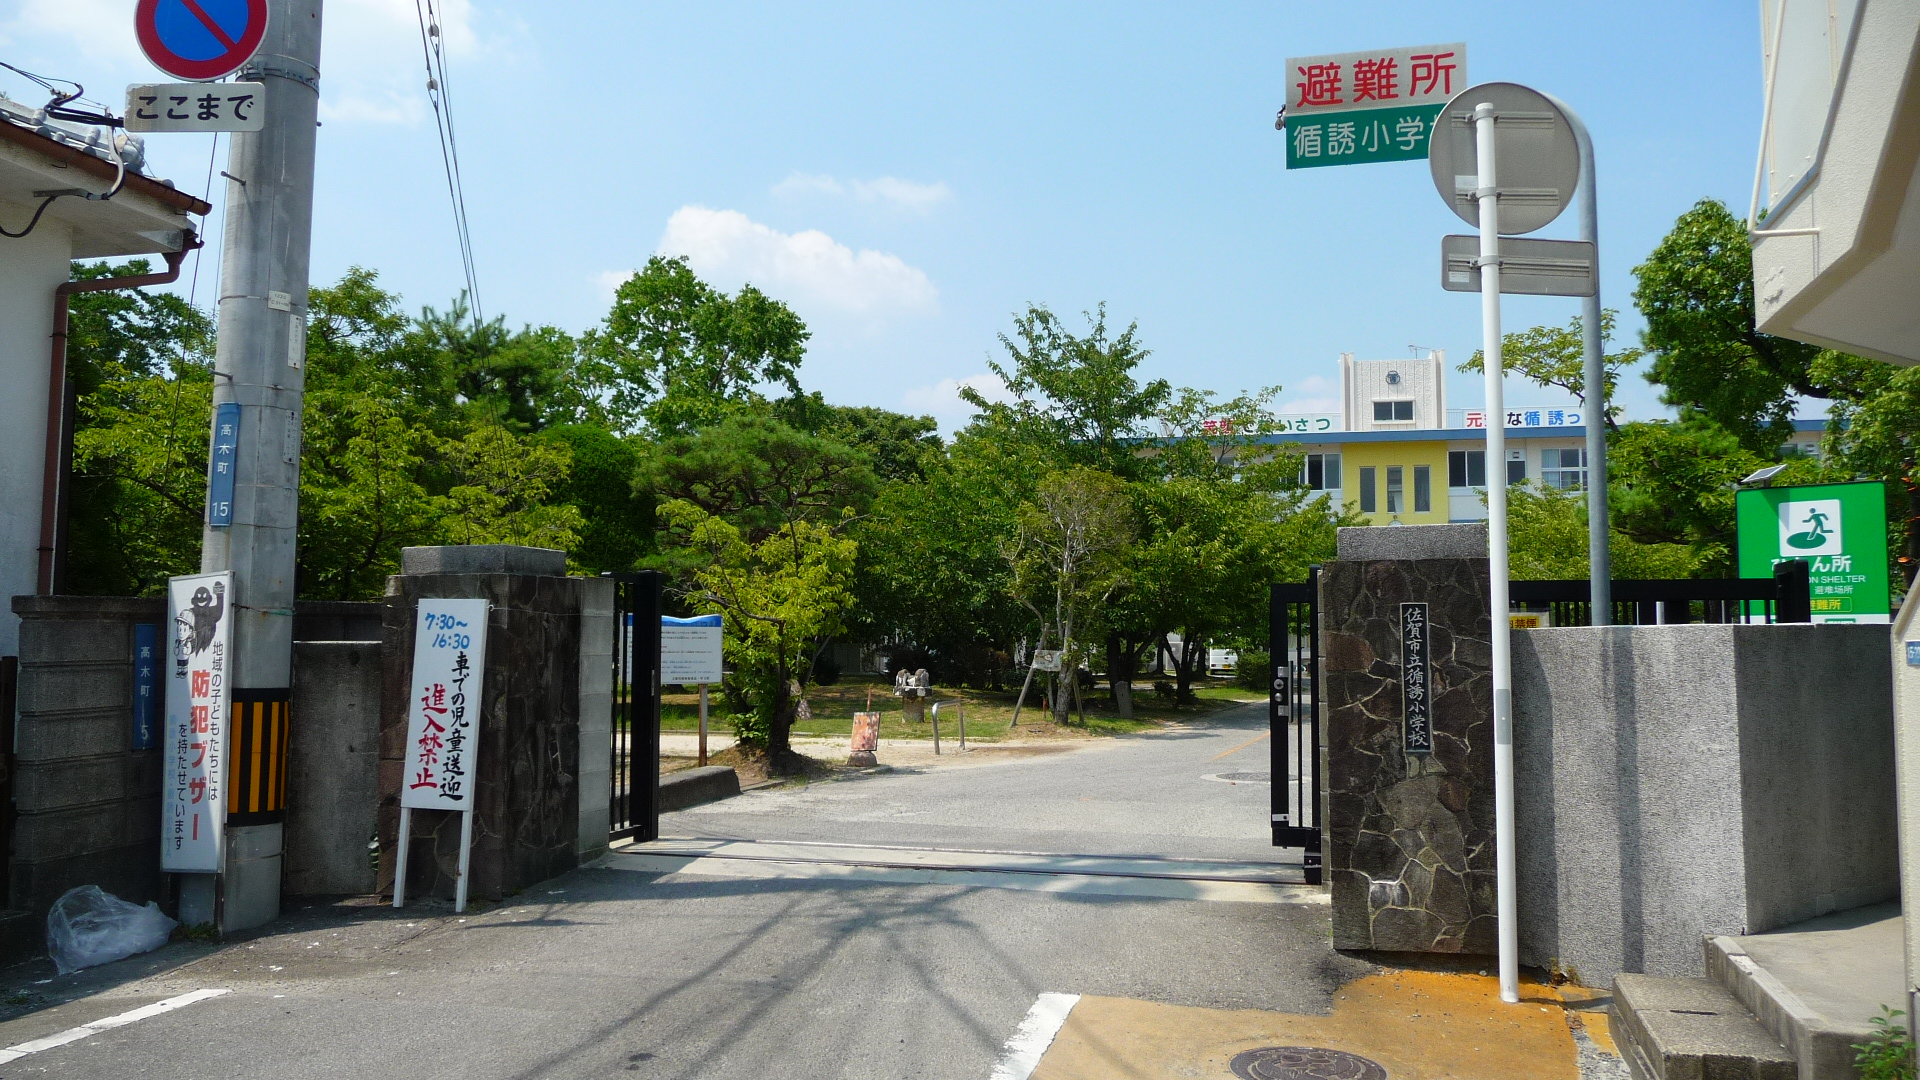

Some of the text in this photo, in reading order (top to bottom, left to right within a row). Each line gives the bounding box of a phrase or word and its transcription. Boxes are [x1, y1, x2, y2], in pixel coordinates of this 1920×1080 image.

[1296, 52, 1457, 108] 避難所
[136, 93, 254, 121] ここまで
[1293, 114, 1438, 159] 循誘小学
[1466, 410, 1581, 428] 元な循誘っ
[217, 424, 232, 475] 高木町
[212, 501, 229, 517] 15
[1820, 575, 1866, 584] SHELTER
[432, 633, 471, 650] 16:30
[140, 646, 151, 697] 高木町
[1403, 607, 1429, 747] 佐賀市立循誘小学校
[207, 640, 224, 801] 地域の子どもたちには
[409, 683, 448, 791] 進入禁止
[439, 650, 470, 801] 車での児童送迎
[188, 669, 211, 841] 防犯ブザー
[174, 723, 188, 850] を持たせています
